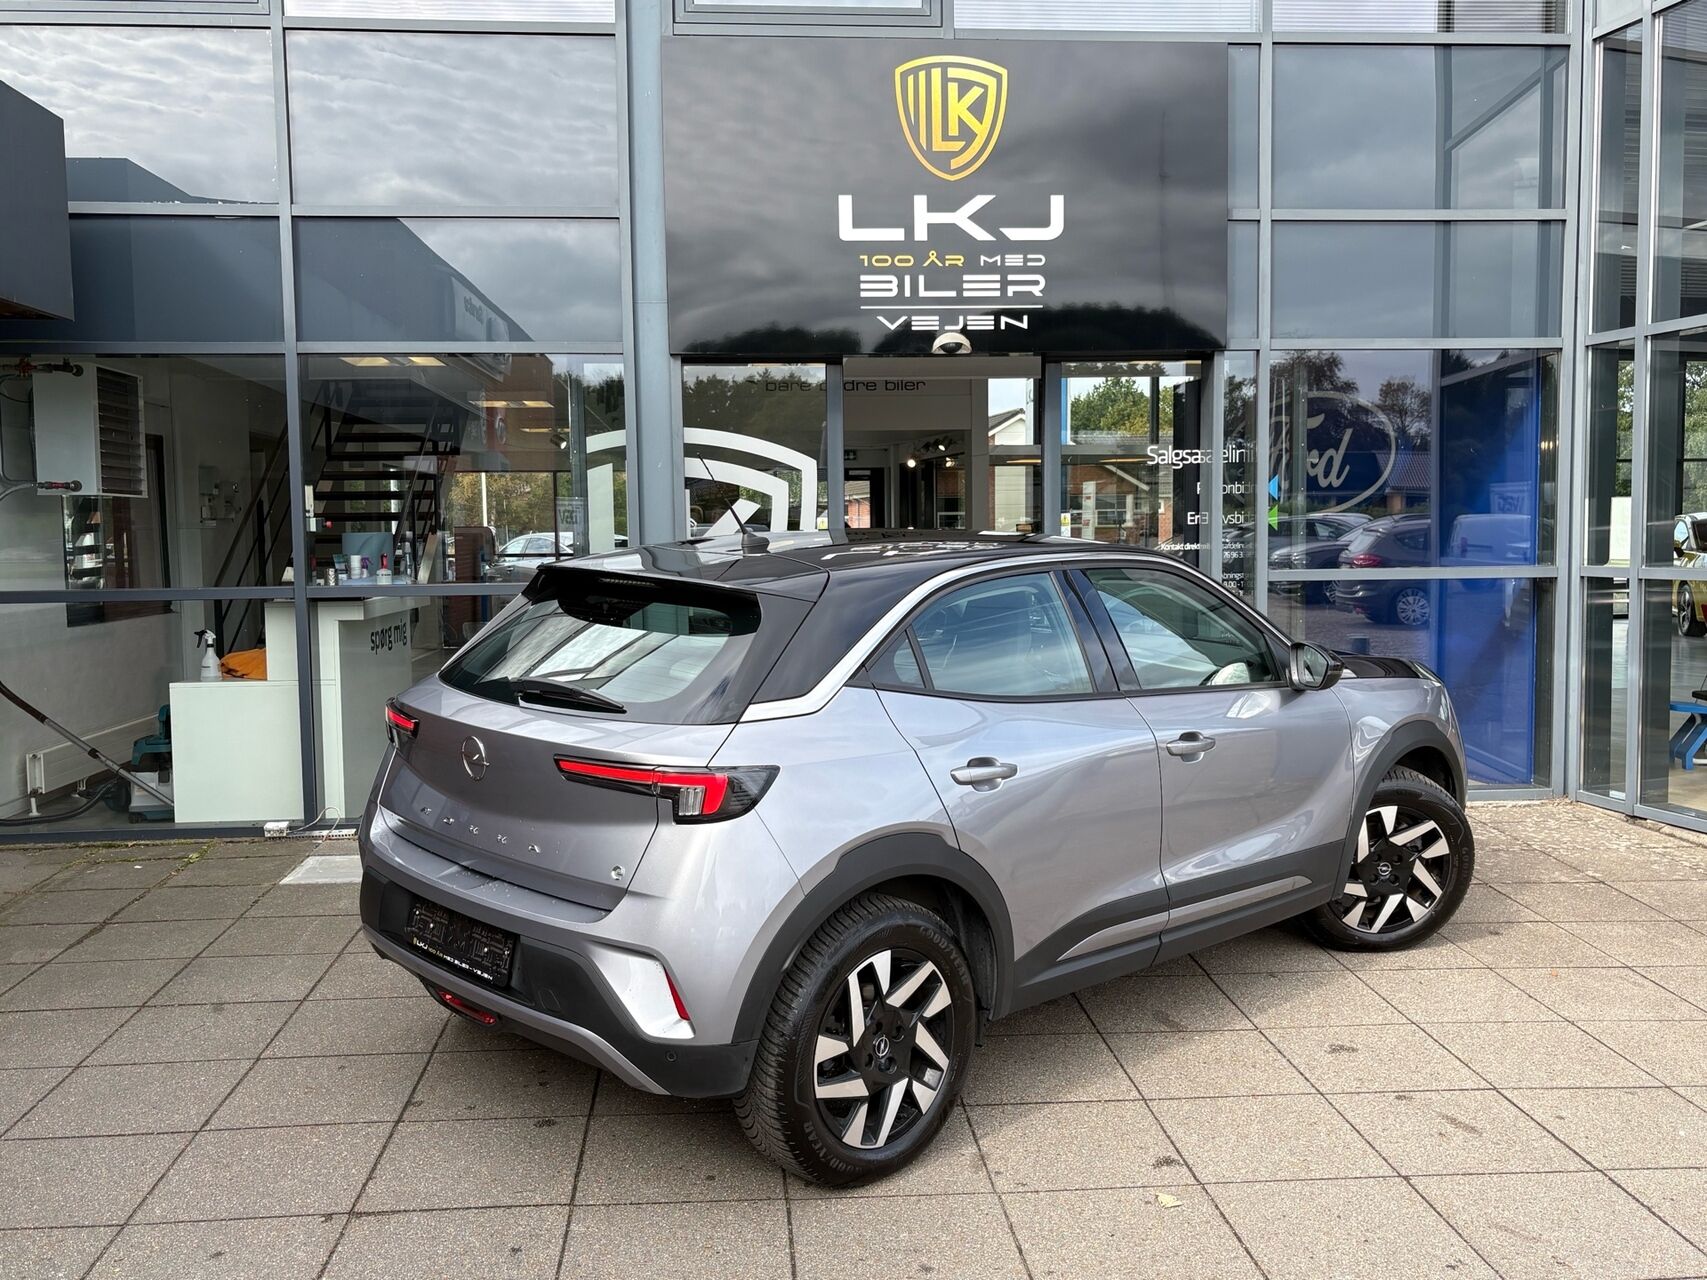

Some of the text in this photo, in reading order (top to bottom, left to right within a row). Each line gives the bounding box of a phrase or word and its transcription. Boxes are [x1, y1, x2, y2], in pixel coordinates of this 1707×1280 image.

[838, 194, 1065, 242] LKJ
[859, 250, 1047, 267] 100 ÅR MED
[859, 274, 1047, 298] BILER
[876, 314, 1029, 331] VEJEN
[765, 379, 811, 392] bare
[884, 379, 927, 392] biler
[393, 618, 408, 646] mig
